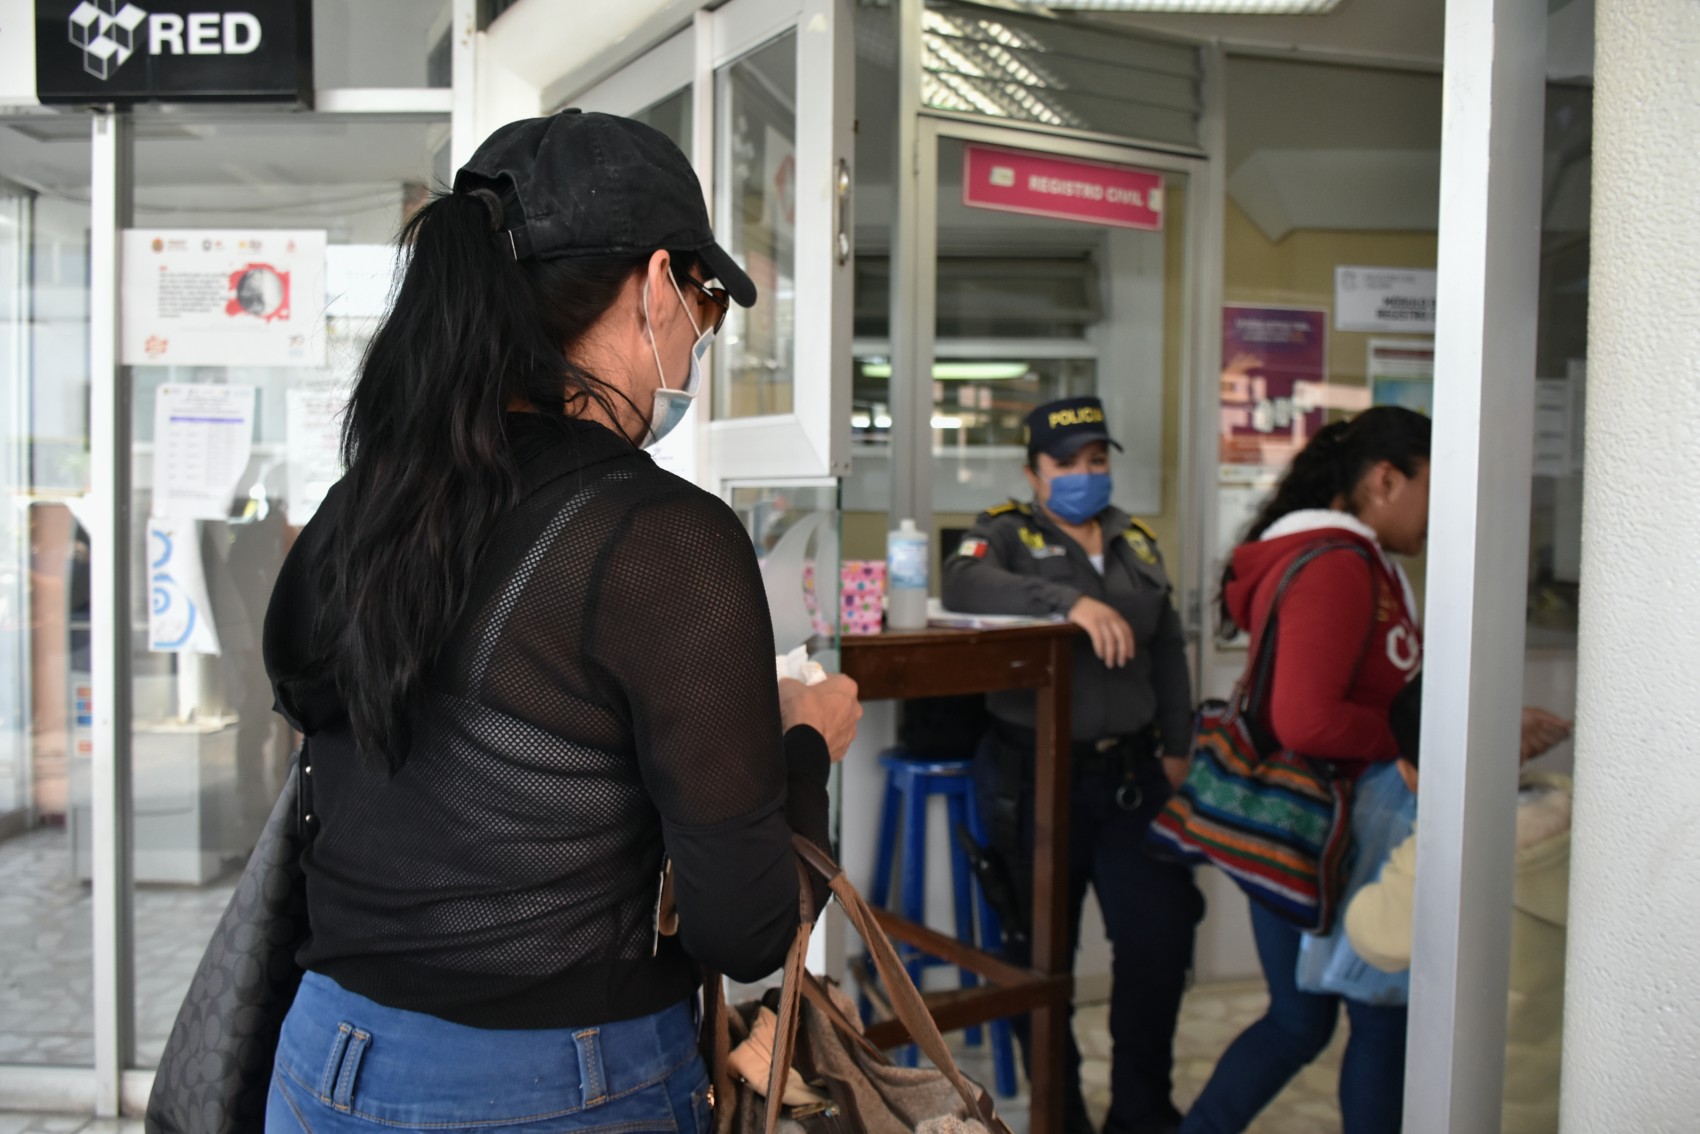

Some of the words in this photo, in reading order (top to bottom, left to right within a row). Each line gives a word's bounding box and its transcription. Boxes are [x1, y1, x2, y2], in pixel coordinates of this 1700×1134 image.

[148, 12, 262, 55] RED
[1028, 174, 1104, 202] REGISTRO
[1105, 186, 1145, 207] CIVIL
